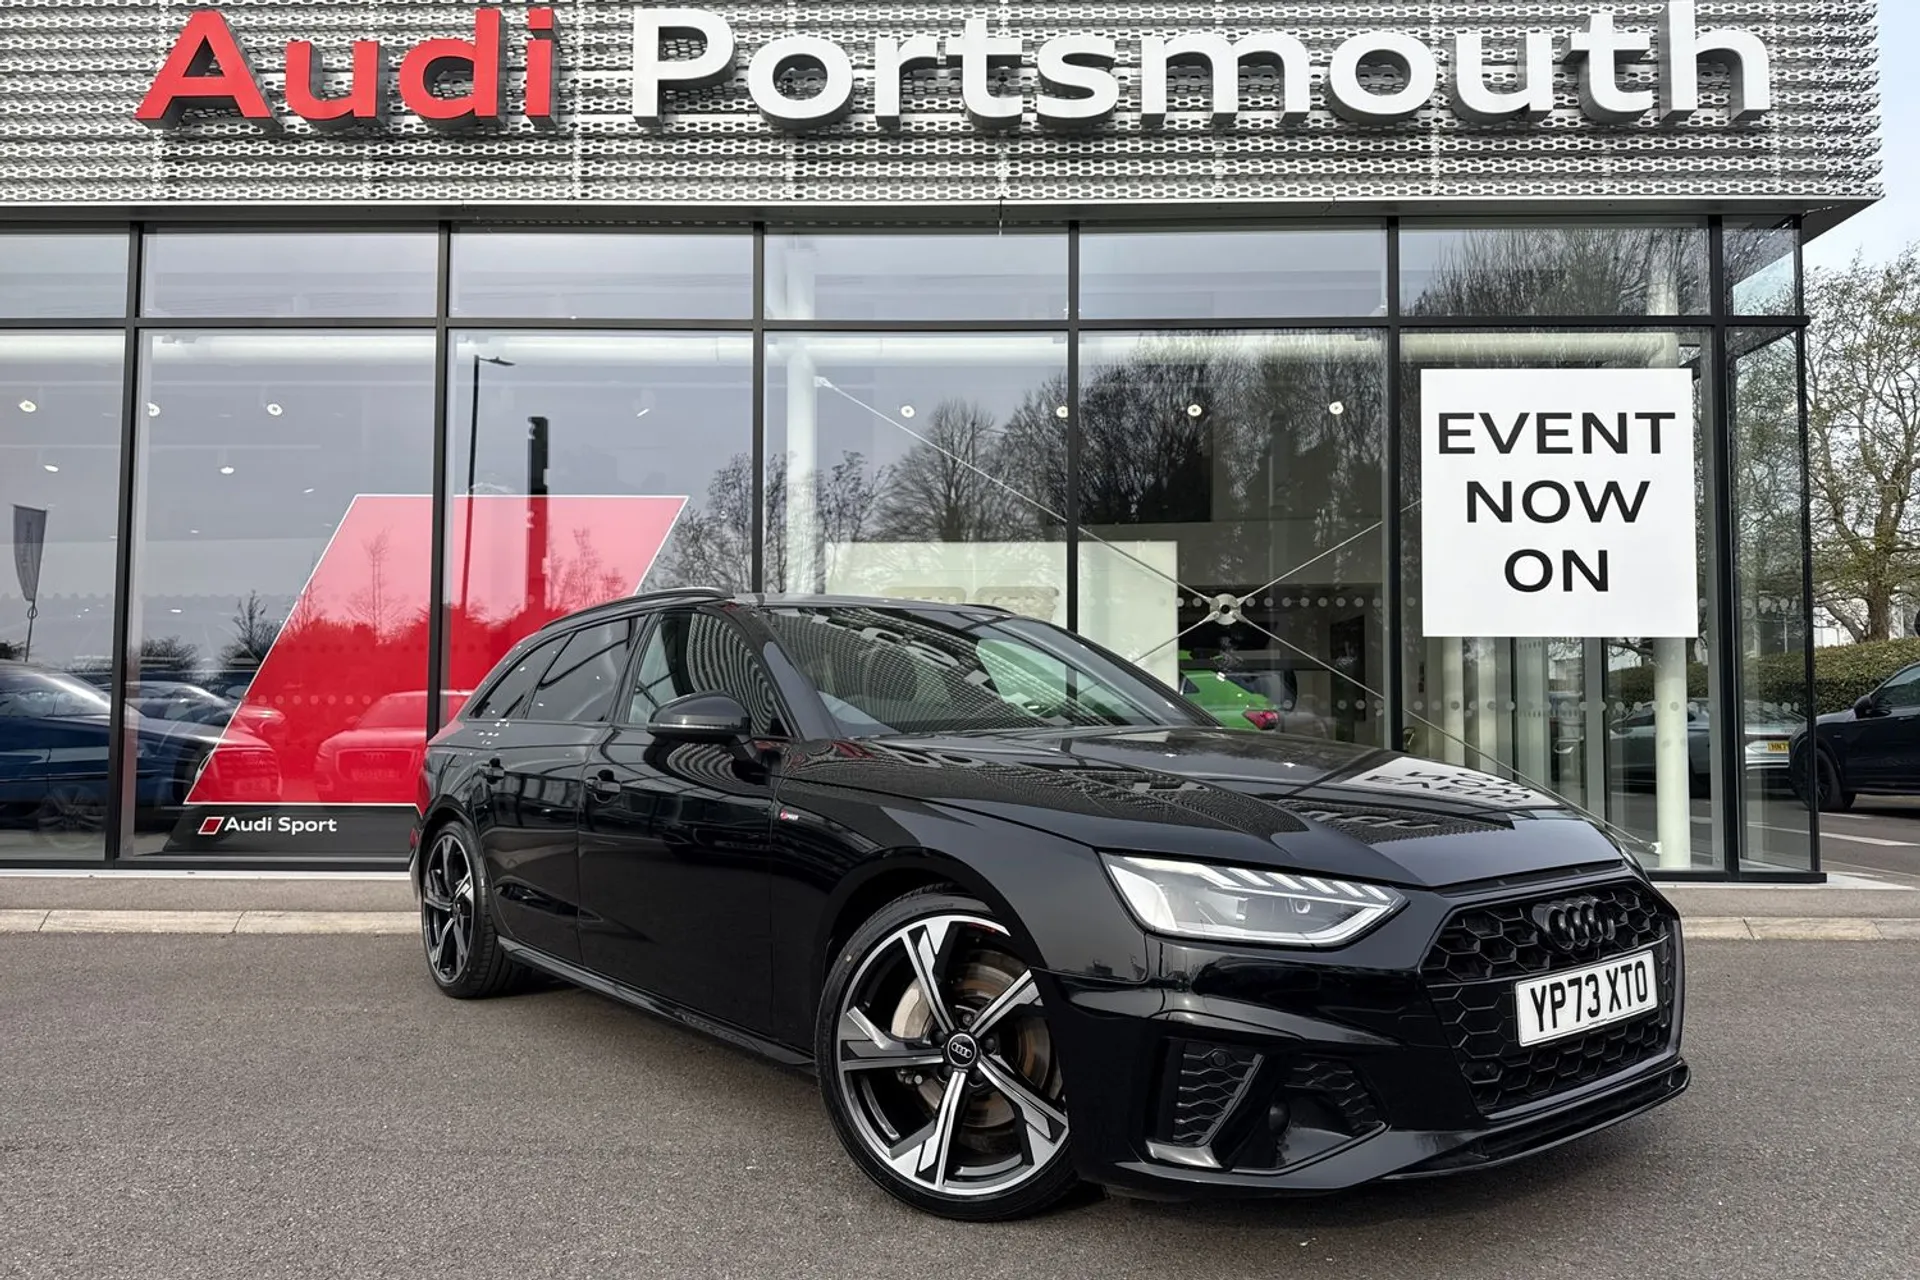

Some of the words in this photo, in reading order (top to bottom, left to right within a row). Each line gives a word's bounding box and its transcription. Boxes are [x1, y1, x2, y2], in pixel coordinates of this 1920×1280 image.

[136, 8, 560, 122] Audi
[632, 0, 1772, 122] Portsmouth
[1438, 412, 1675, 454] EVENT
[1466, 480, 1650, 523] NOW
[1503, 549, 1609, 592] ON
[224, 817, 272, 832] Audi
[278, 817, 337, 835] Sport
[1530, 974, 1601, 1032] YP73
[1605, 960, 1648, 1013] XTO
